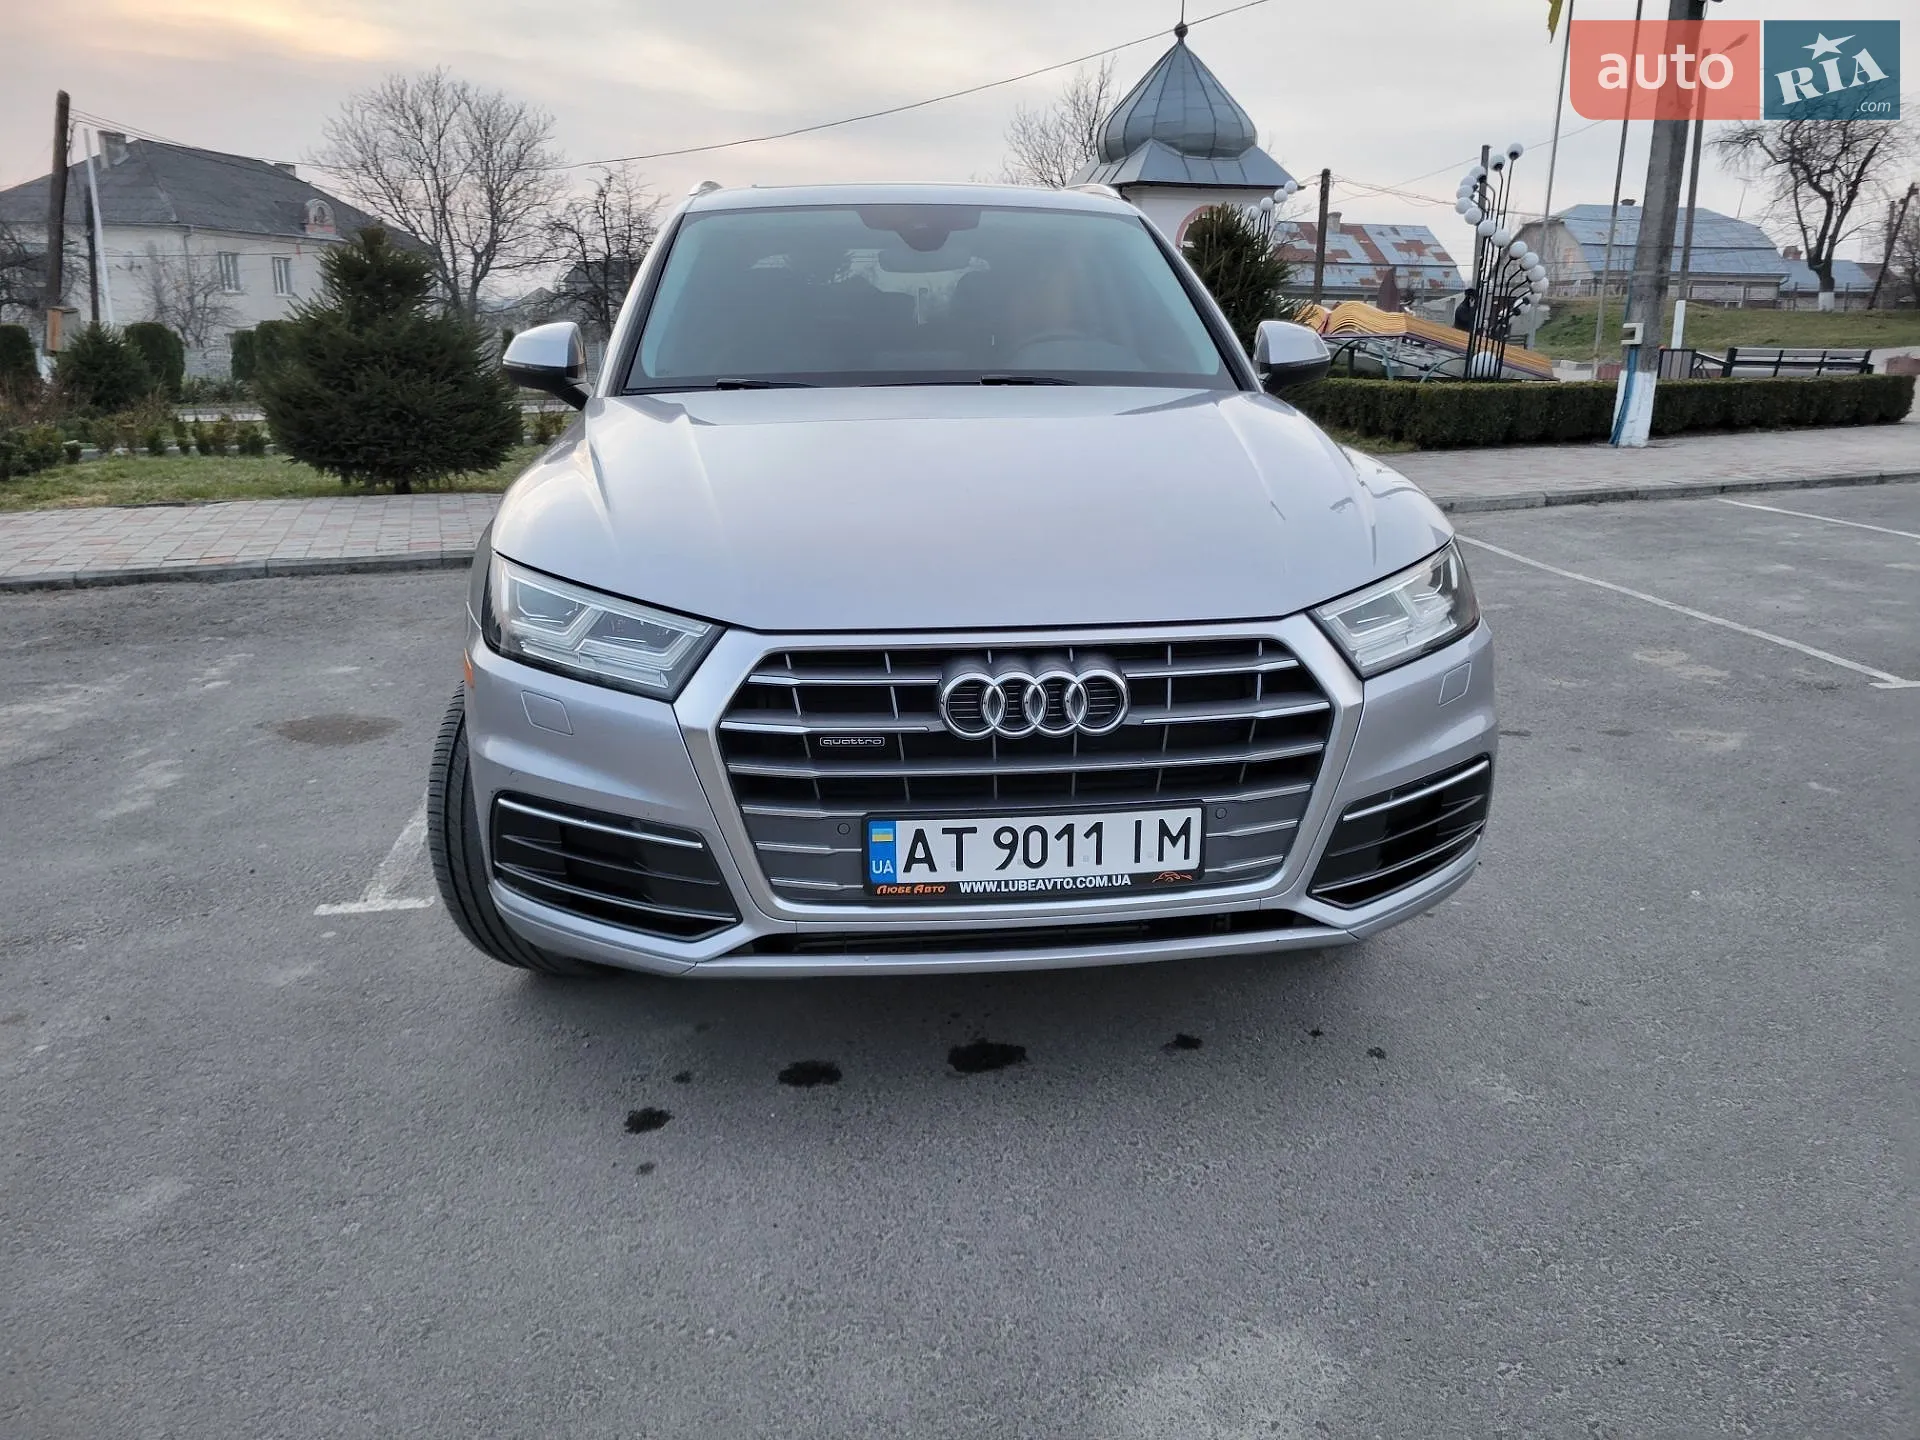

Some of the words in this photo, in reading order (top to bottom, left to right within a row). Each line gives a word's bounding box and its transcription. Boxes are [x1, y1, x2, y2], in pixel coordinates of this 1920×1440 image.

[903, 827, 977, 873] AT
[993, 822, 1104, 871] 9011
[1134, 816, 1192, 864] IM
[872, 860, 894, 874] UA
[959, 874, 1132, 893] WWW.LUBEAVTO.COM.UA
